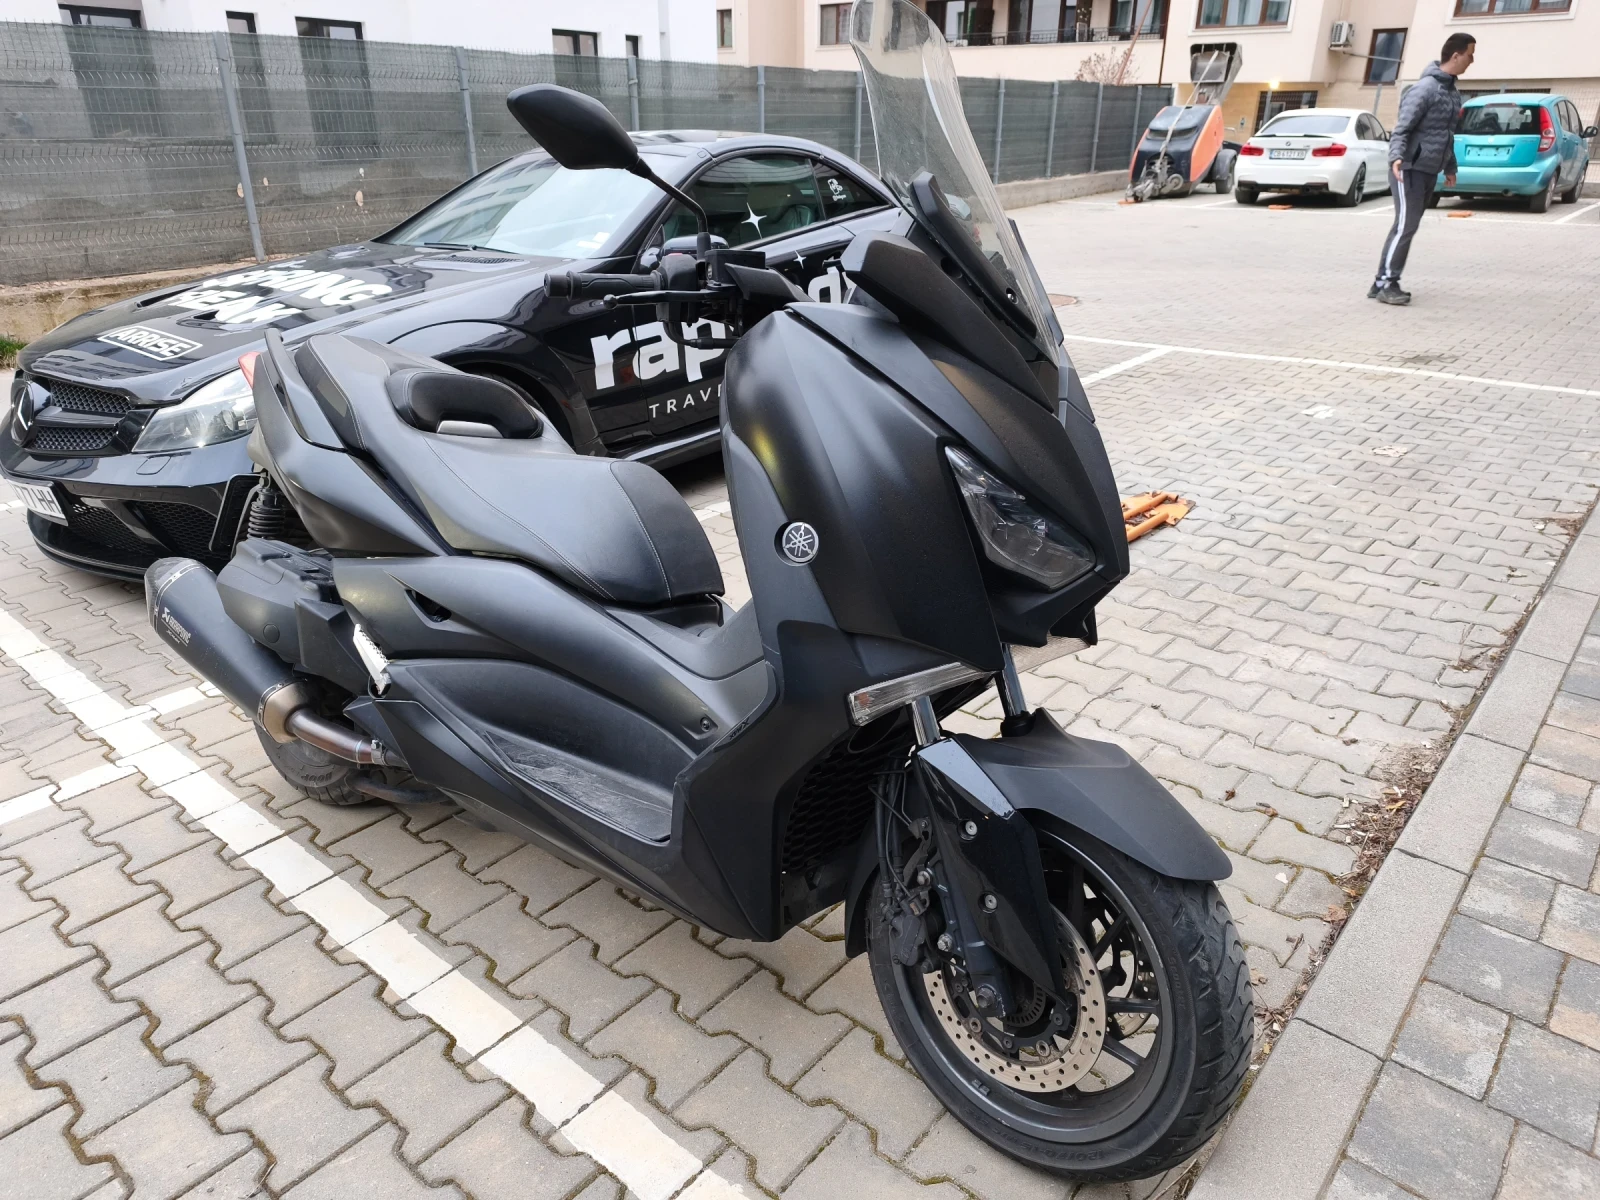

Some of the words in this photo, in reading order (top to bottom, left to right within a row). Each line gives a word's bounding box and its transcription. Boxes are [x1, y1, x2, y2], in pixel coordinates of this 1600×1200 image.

[109, 328, 193, 357] ARRISE
[590, 317, 736, 390] rap
[649, 383, 721, 418] TRAV
